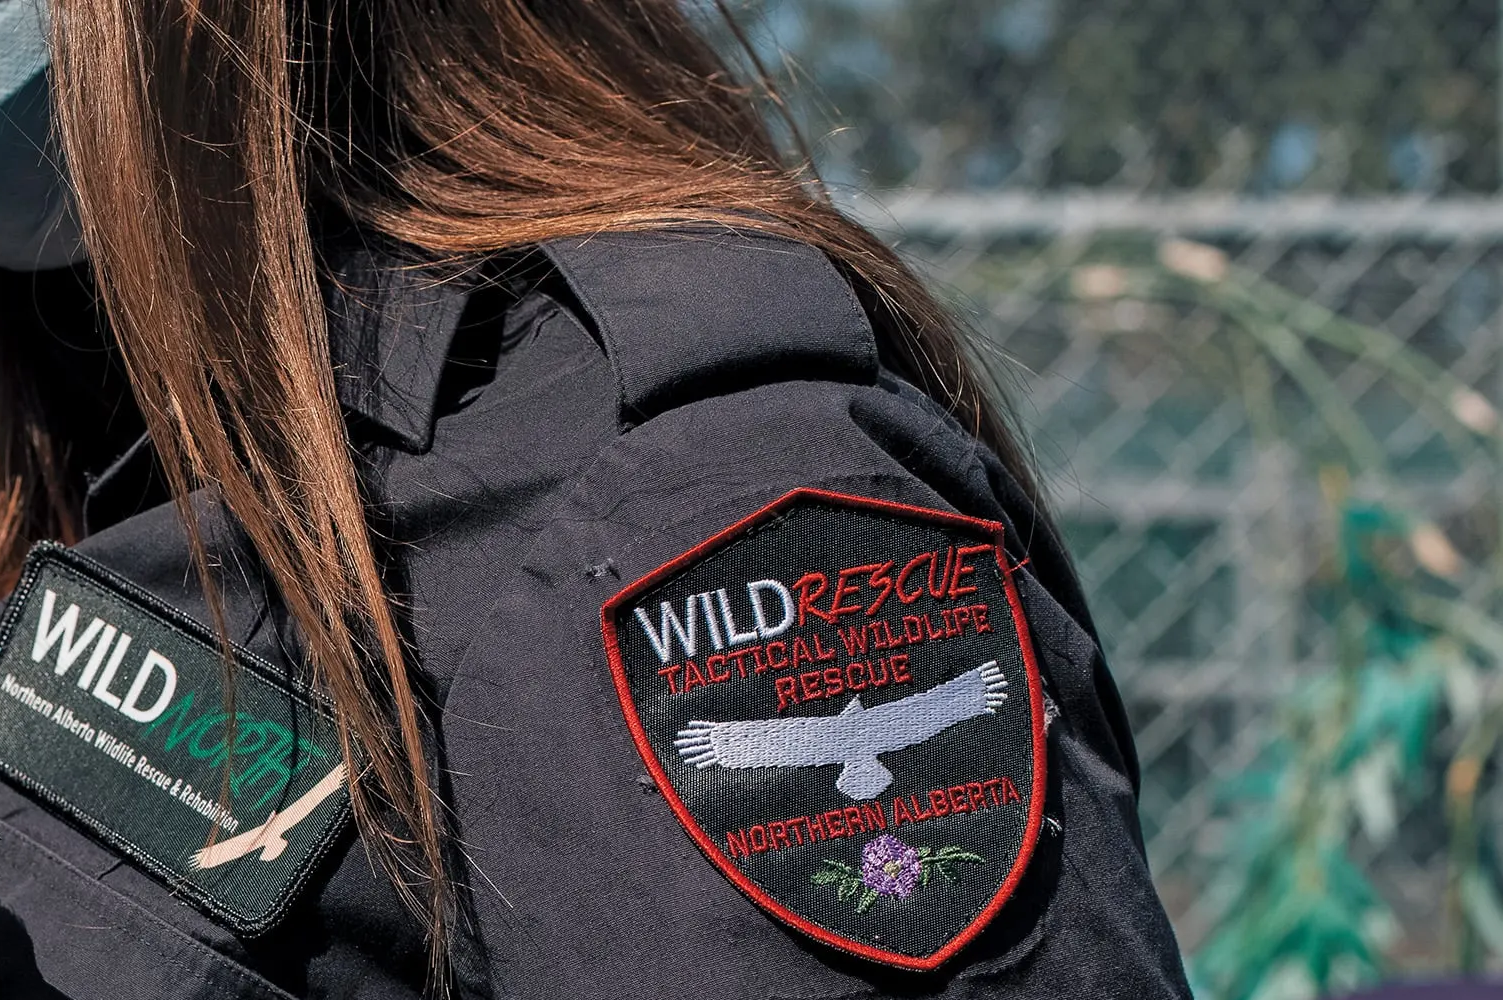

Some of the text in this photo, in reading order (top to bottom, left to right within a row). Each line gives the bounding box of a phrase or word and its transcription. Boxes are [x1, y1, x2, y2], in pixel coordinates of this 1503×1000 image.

[658, 604, 994, 695] TACTICAL WILDLIFE
[776, 654, 914, 711] RESCUE
[1, 674, 55, 717] Northern
[52, 704, 96, 744] Alberta
[95, 728, 137, 769] Wildlife
[136, 753, 171, 792] Rescue
[170, 775, 182, 798] &
[726, 778, 1022, 858] NORTHERN ALBERTA
